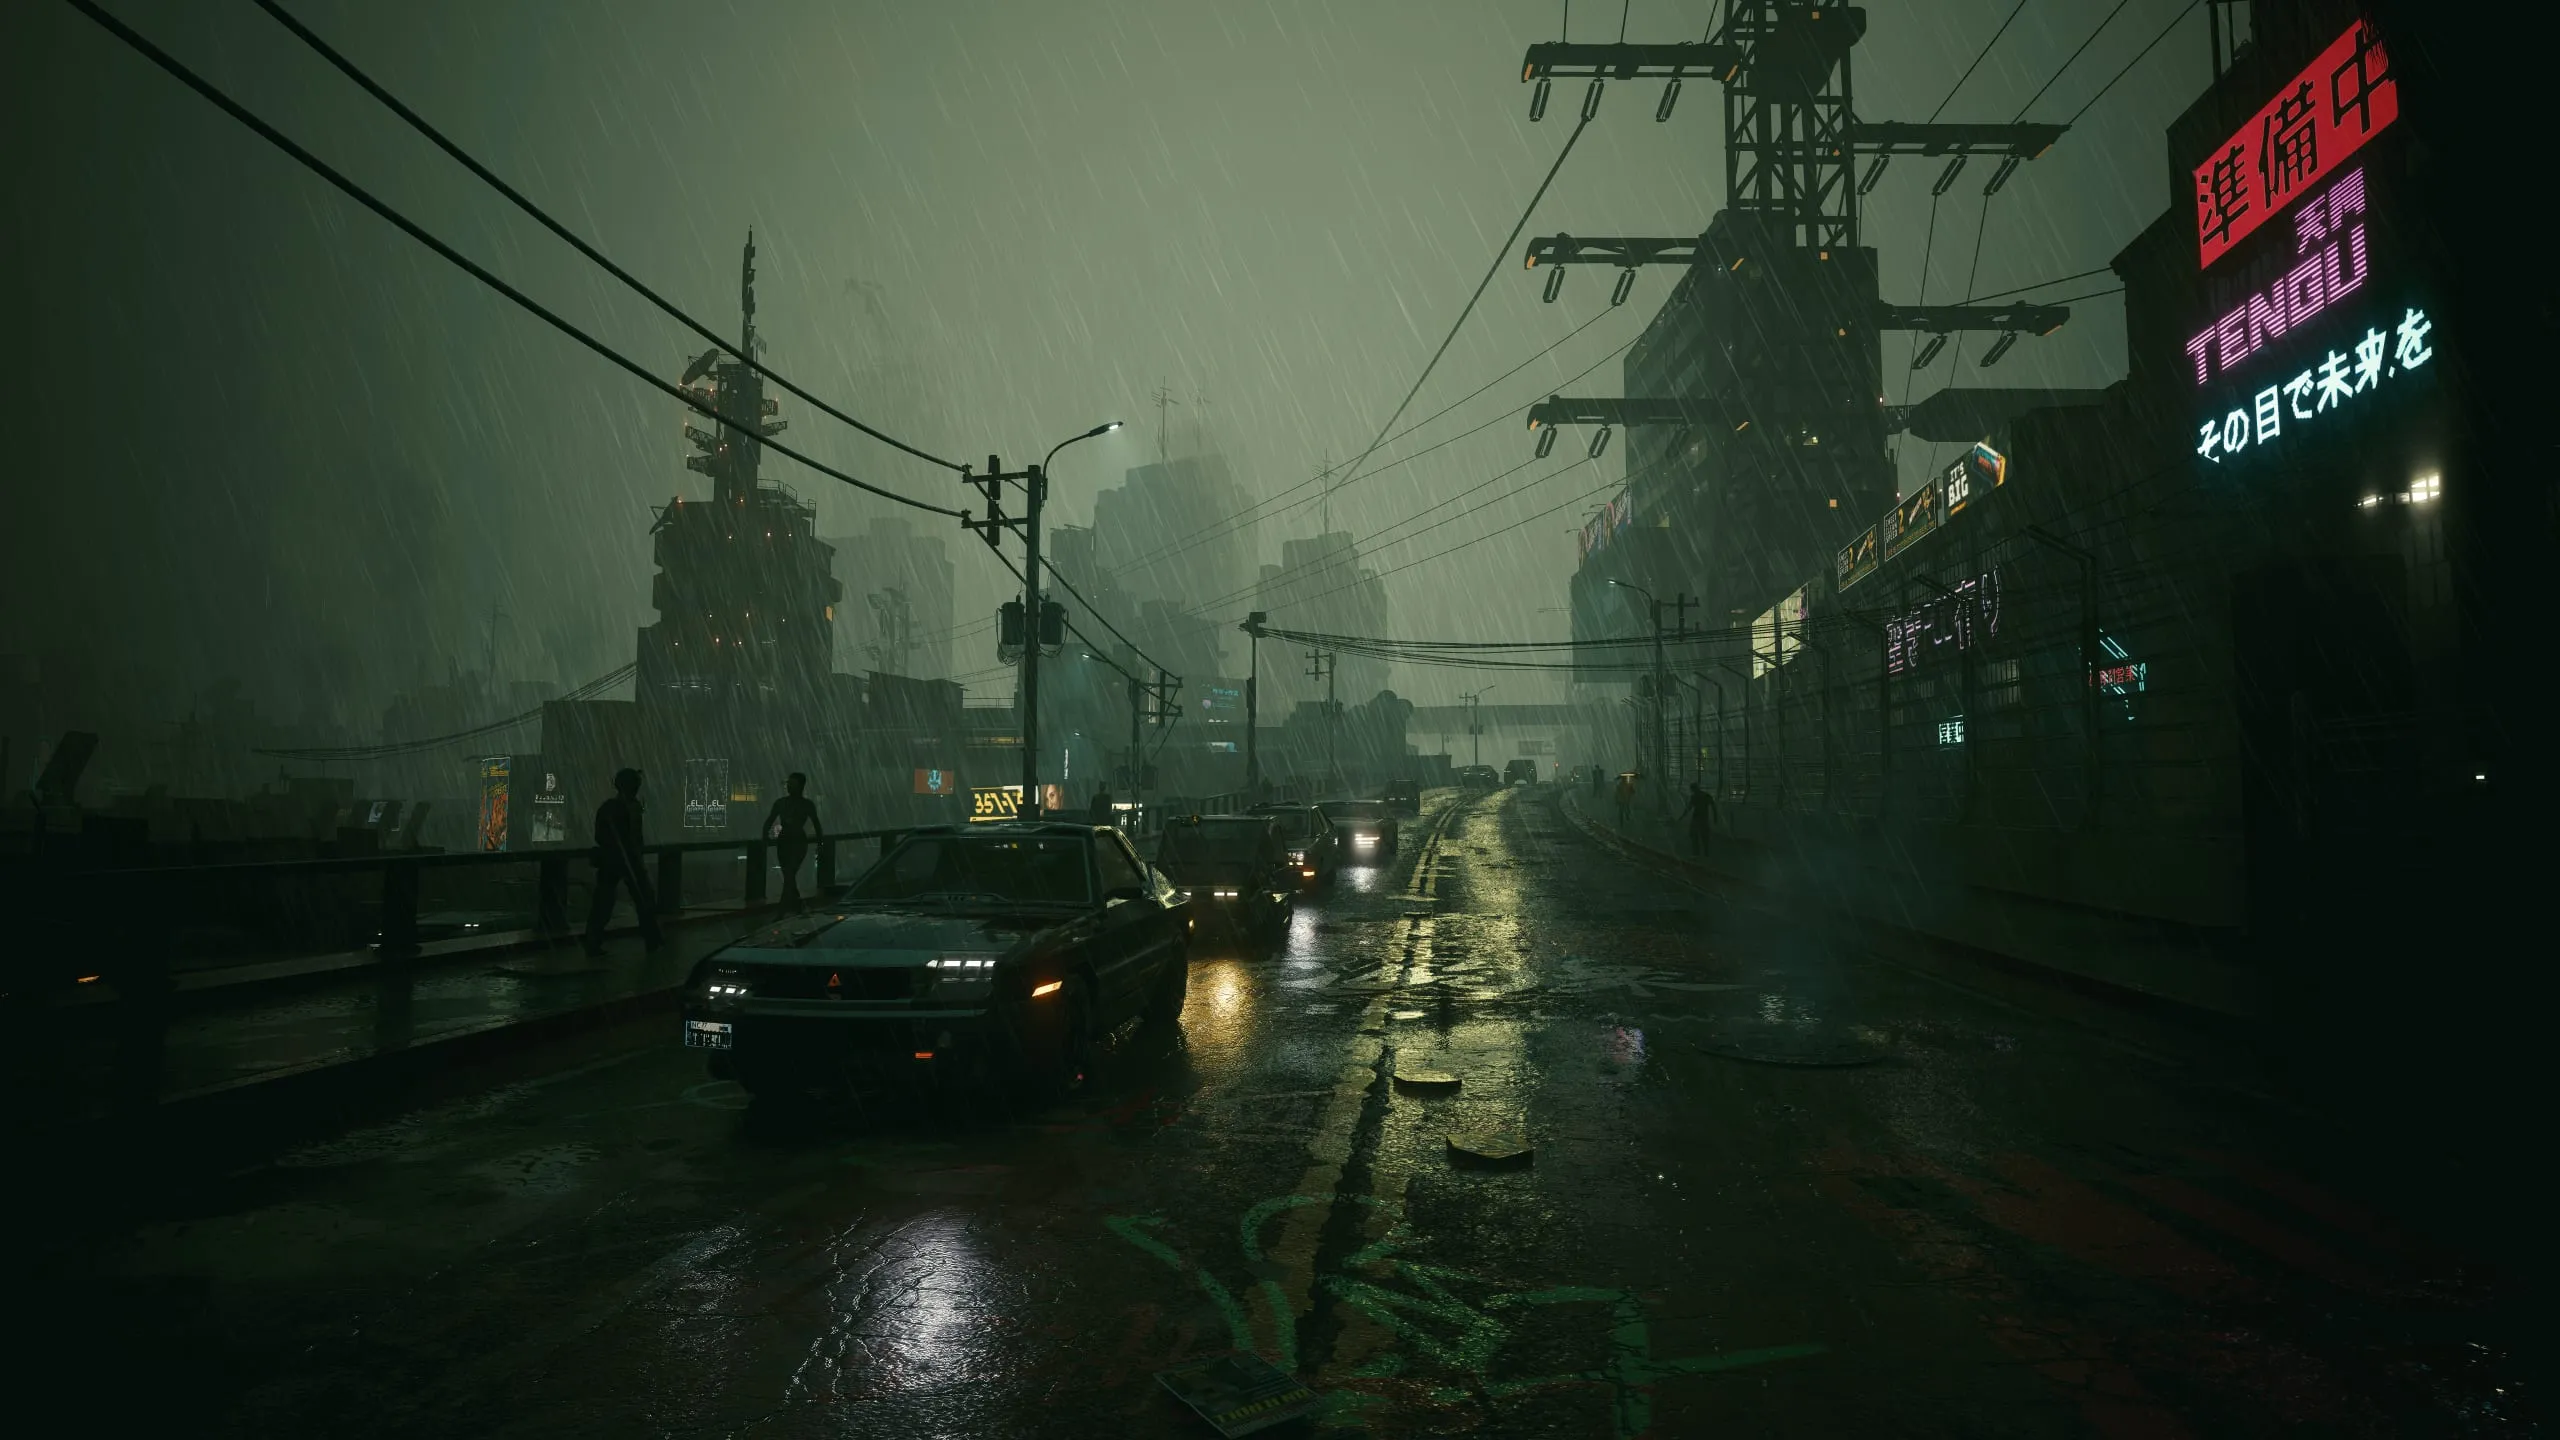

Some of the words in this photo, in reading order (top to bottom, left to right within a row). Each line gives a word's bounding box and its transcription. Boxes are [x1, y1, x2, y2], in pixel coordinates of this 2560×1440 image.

[2203, 25, 2390, 245] 準備中
[2186, 223, 2368, 386] TENGU
[2196, 307, 2433, 464] その目で未来を
[1948, 474, 1969, 507] BIG
[1950, 461, 1965, 483] IT'S
